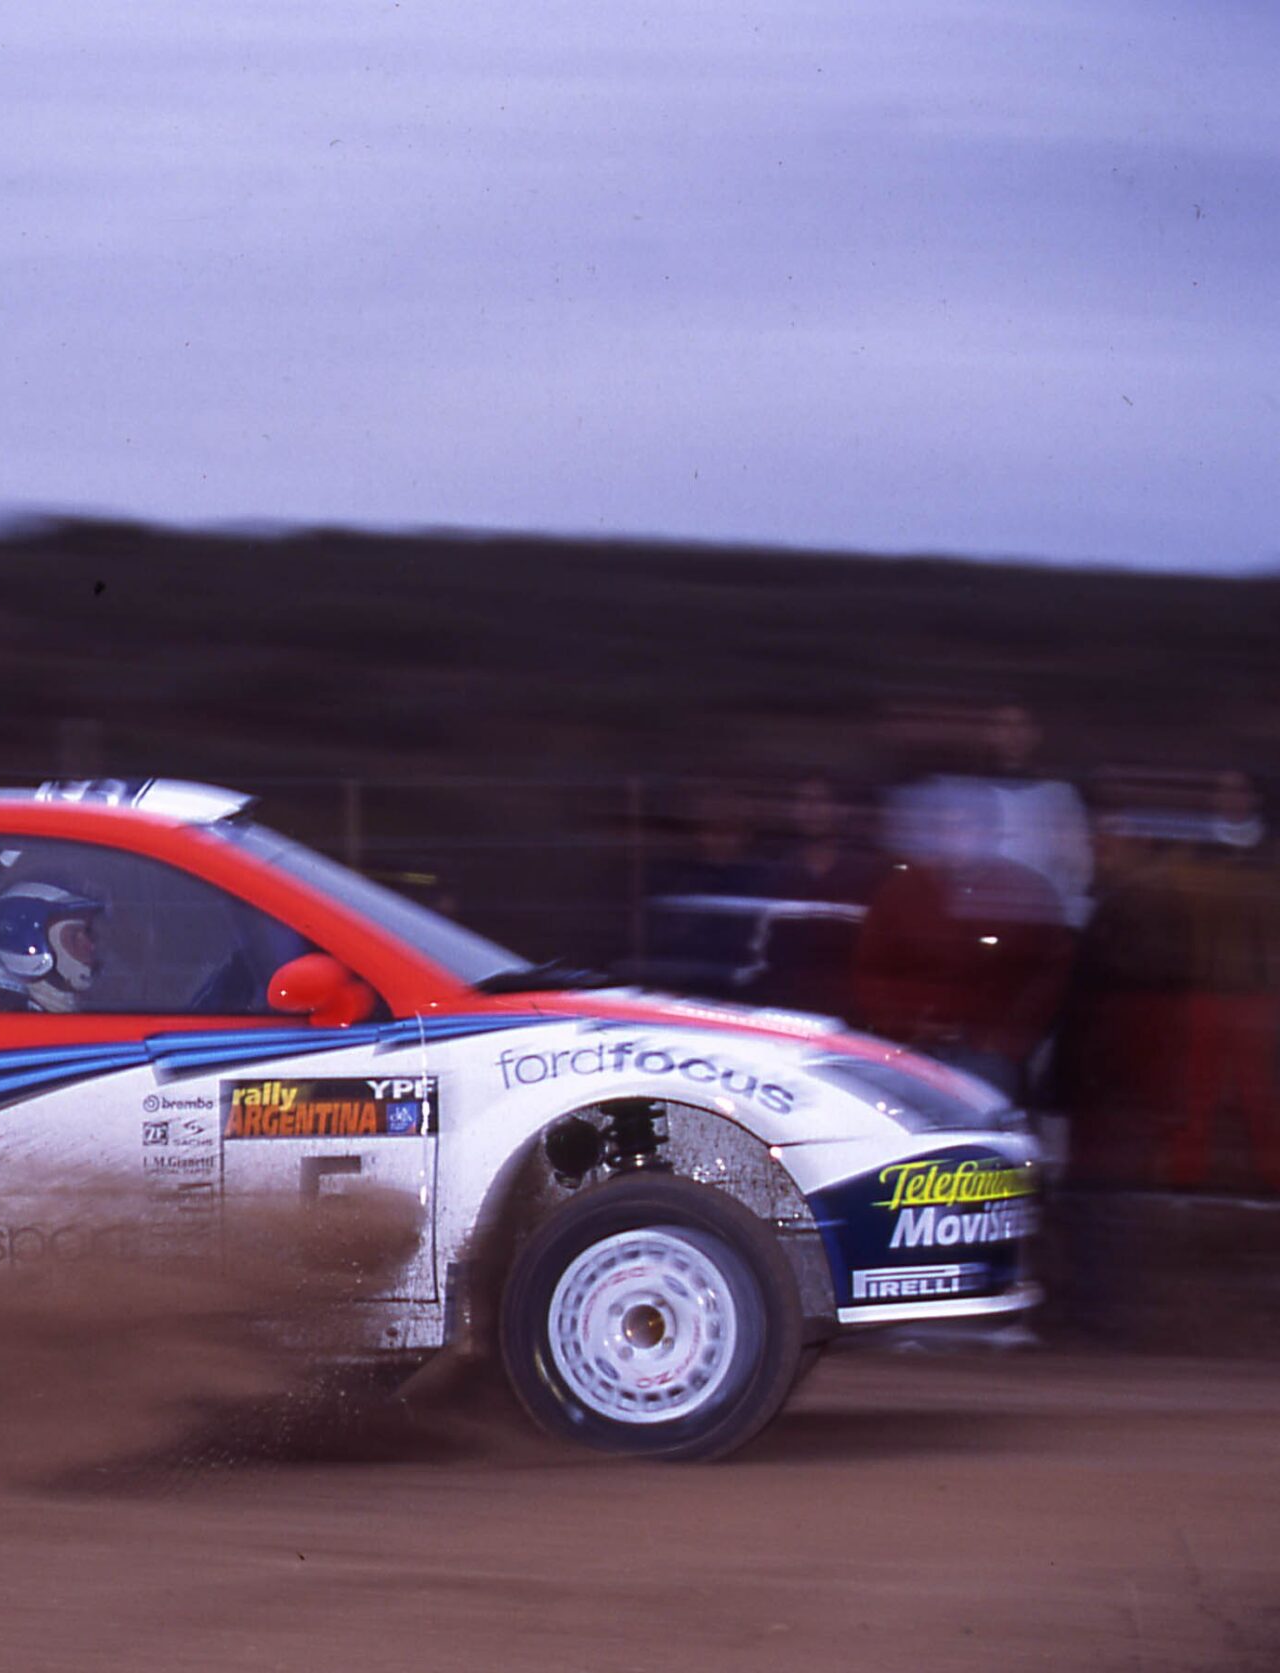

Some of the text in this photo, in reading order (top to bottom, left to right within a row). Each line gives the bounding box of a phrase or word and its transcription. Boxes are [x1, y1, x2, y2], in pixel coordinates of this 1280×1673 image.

[161, 1097, 215, 1110] brembo
[232, 1082, 297, 1111] rally
[367, 1079, 435, 1100] YPF
[224, 1102, 378, 1137] ARGENTINA
[852, 1264, 961, 1299] PIRELLI
